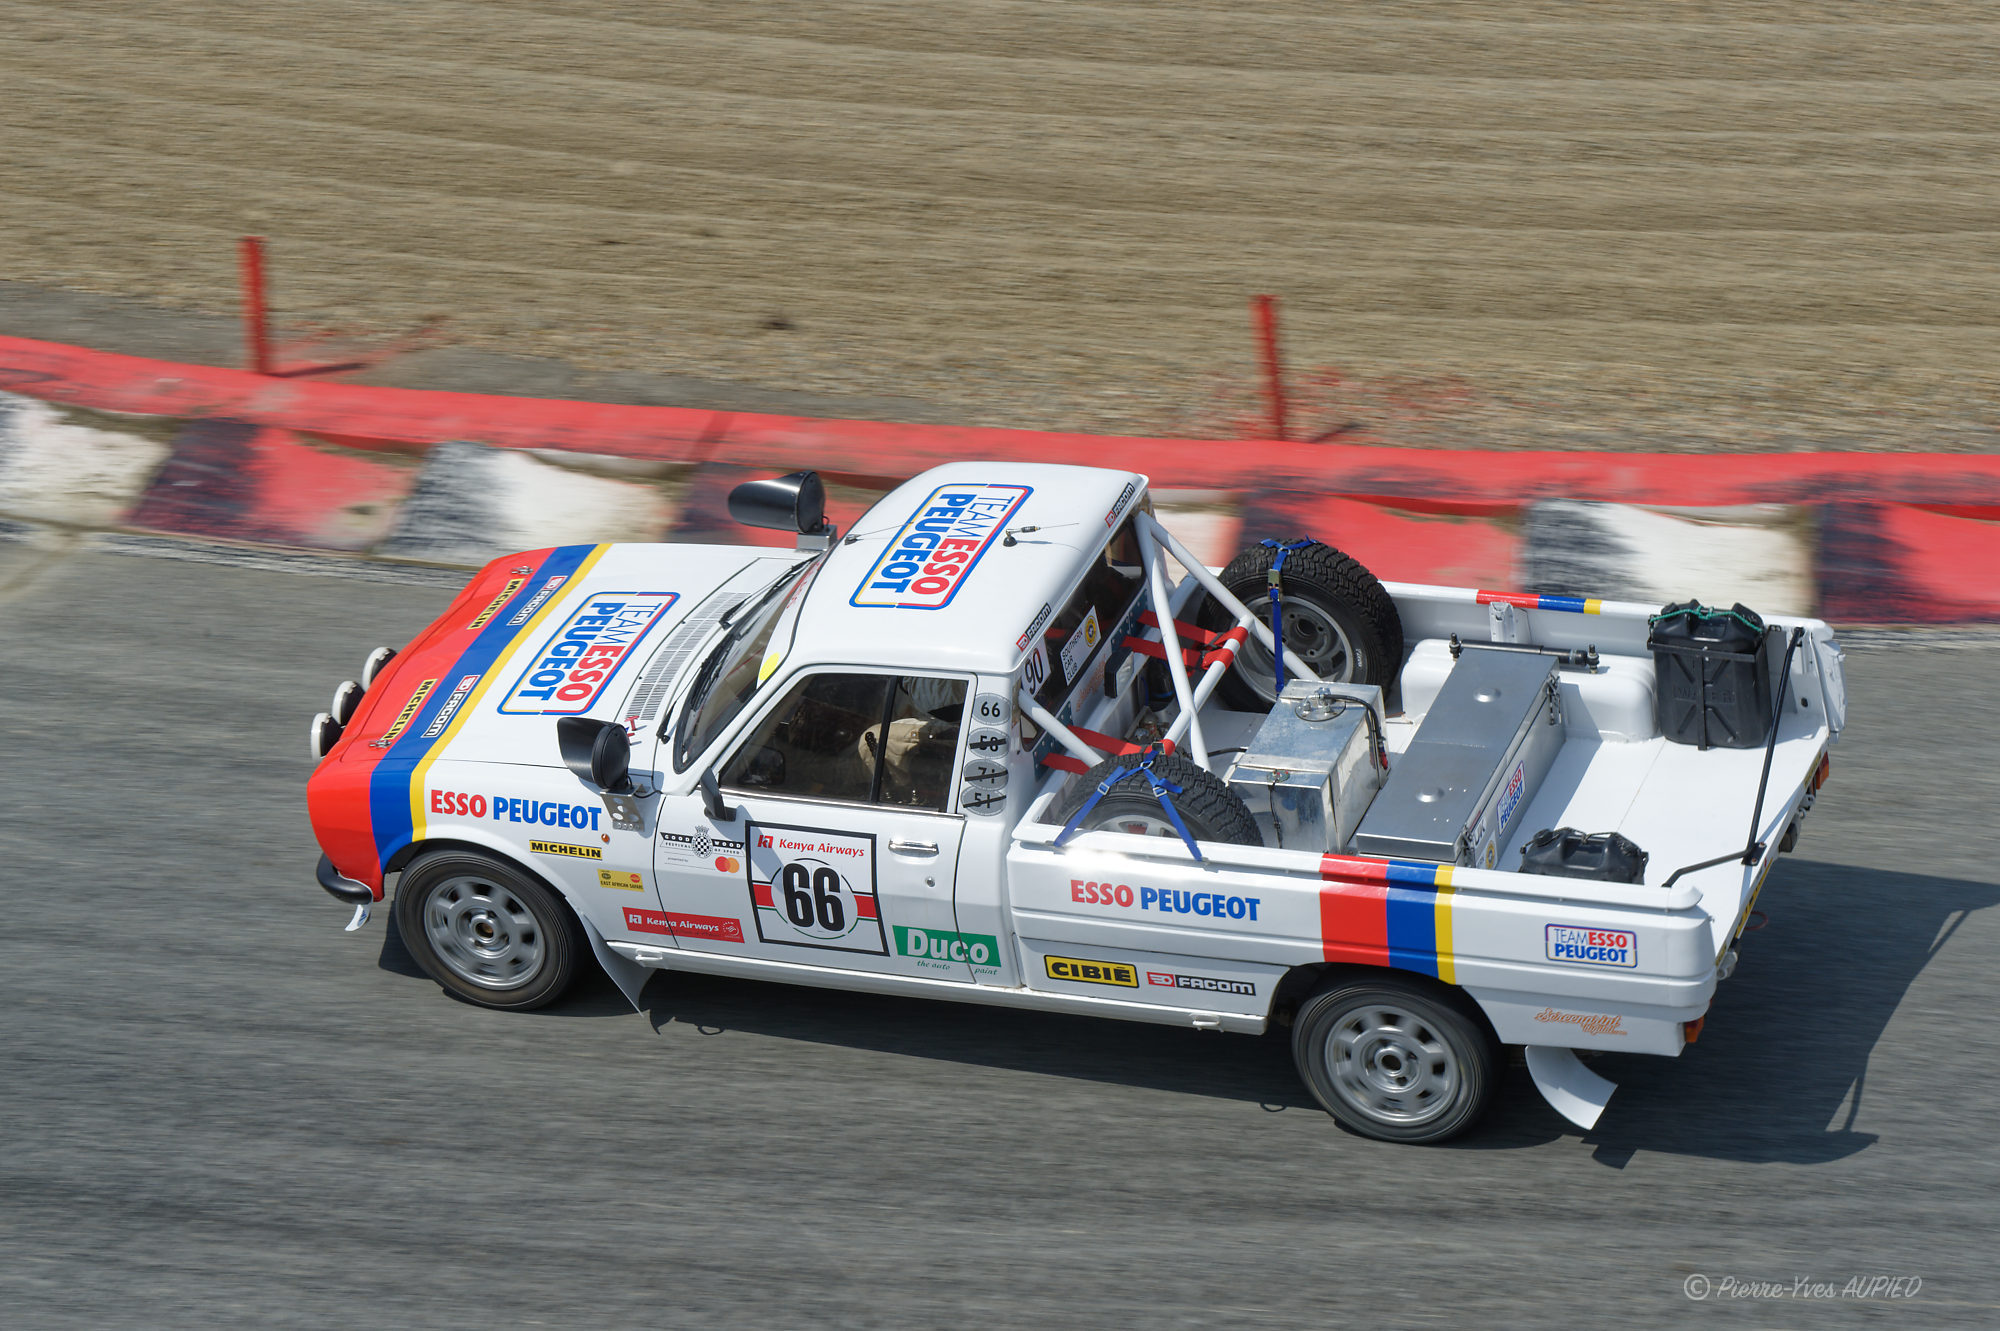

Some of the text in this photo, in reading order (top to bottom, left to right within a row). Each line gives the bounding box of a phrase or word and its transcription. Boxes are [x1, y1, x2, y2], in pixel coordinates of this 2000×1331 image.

[870, 494, 978, 593] PEUGEOT
[471, 580, 521, 628] MICHELIN
[512, 590, 551, 624] FACOM
[1027, 605, 1050, 638] FACOM
[518, 602, 626, 701] PEUGEOT
[1064, 655, 1074, 671] CAR
[1025, 648, 1043, 695] 90
[1066, 662, 1078, 681] CLUB
[384, 680, 435, 740] MICHELIN
[427, 692, 465, 736] FACOM
[981, 701, 1000, 718] 66
[431, 789, 602, 831] ESSO PEUGEOT
[1501, 780, 1523, 829] PEUGEOT
[532, 842, 601, 858] MICHELIN
[779, 838, 815, 853] Kenya
[818, 842, 865, 857] Airways
[783, 863, 845, 932] 66
[1070, 880, 1260, 921] ESSO PEUGEOT
[646, 917, 677, 927] Kenya
[680, 919, 719, 932] Airways
[907, 928, 989, 964] Duco
[1555, 943, 1628, 963] PEUGEOT
[974, 967, 998, 976] paint
[1052, 962, 1132, 983] CIBIÉ
[1179, 976, 1253, 994] FACOM
